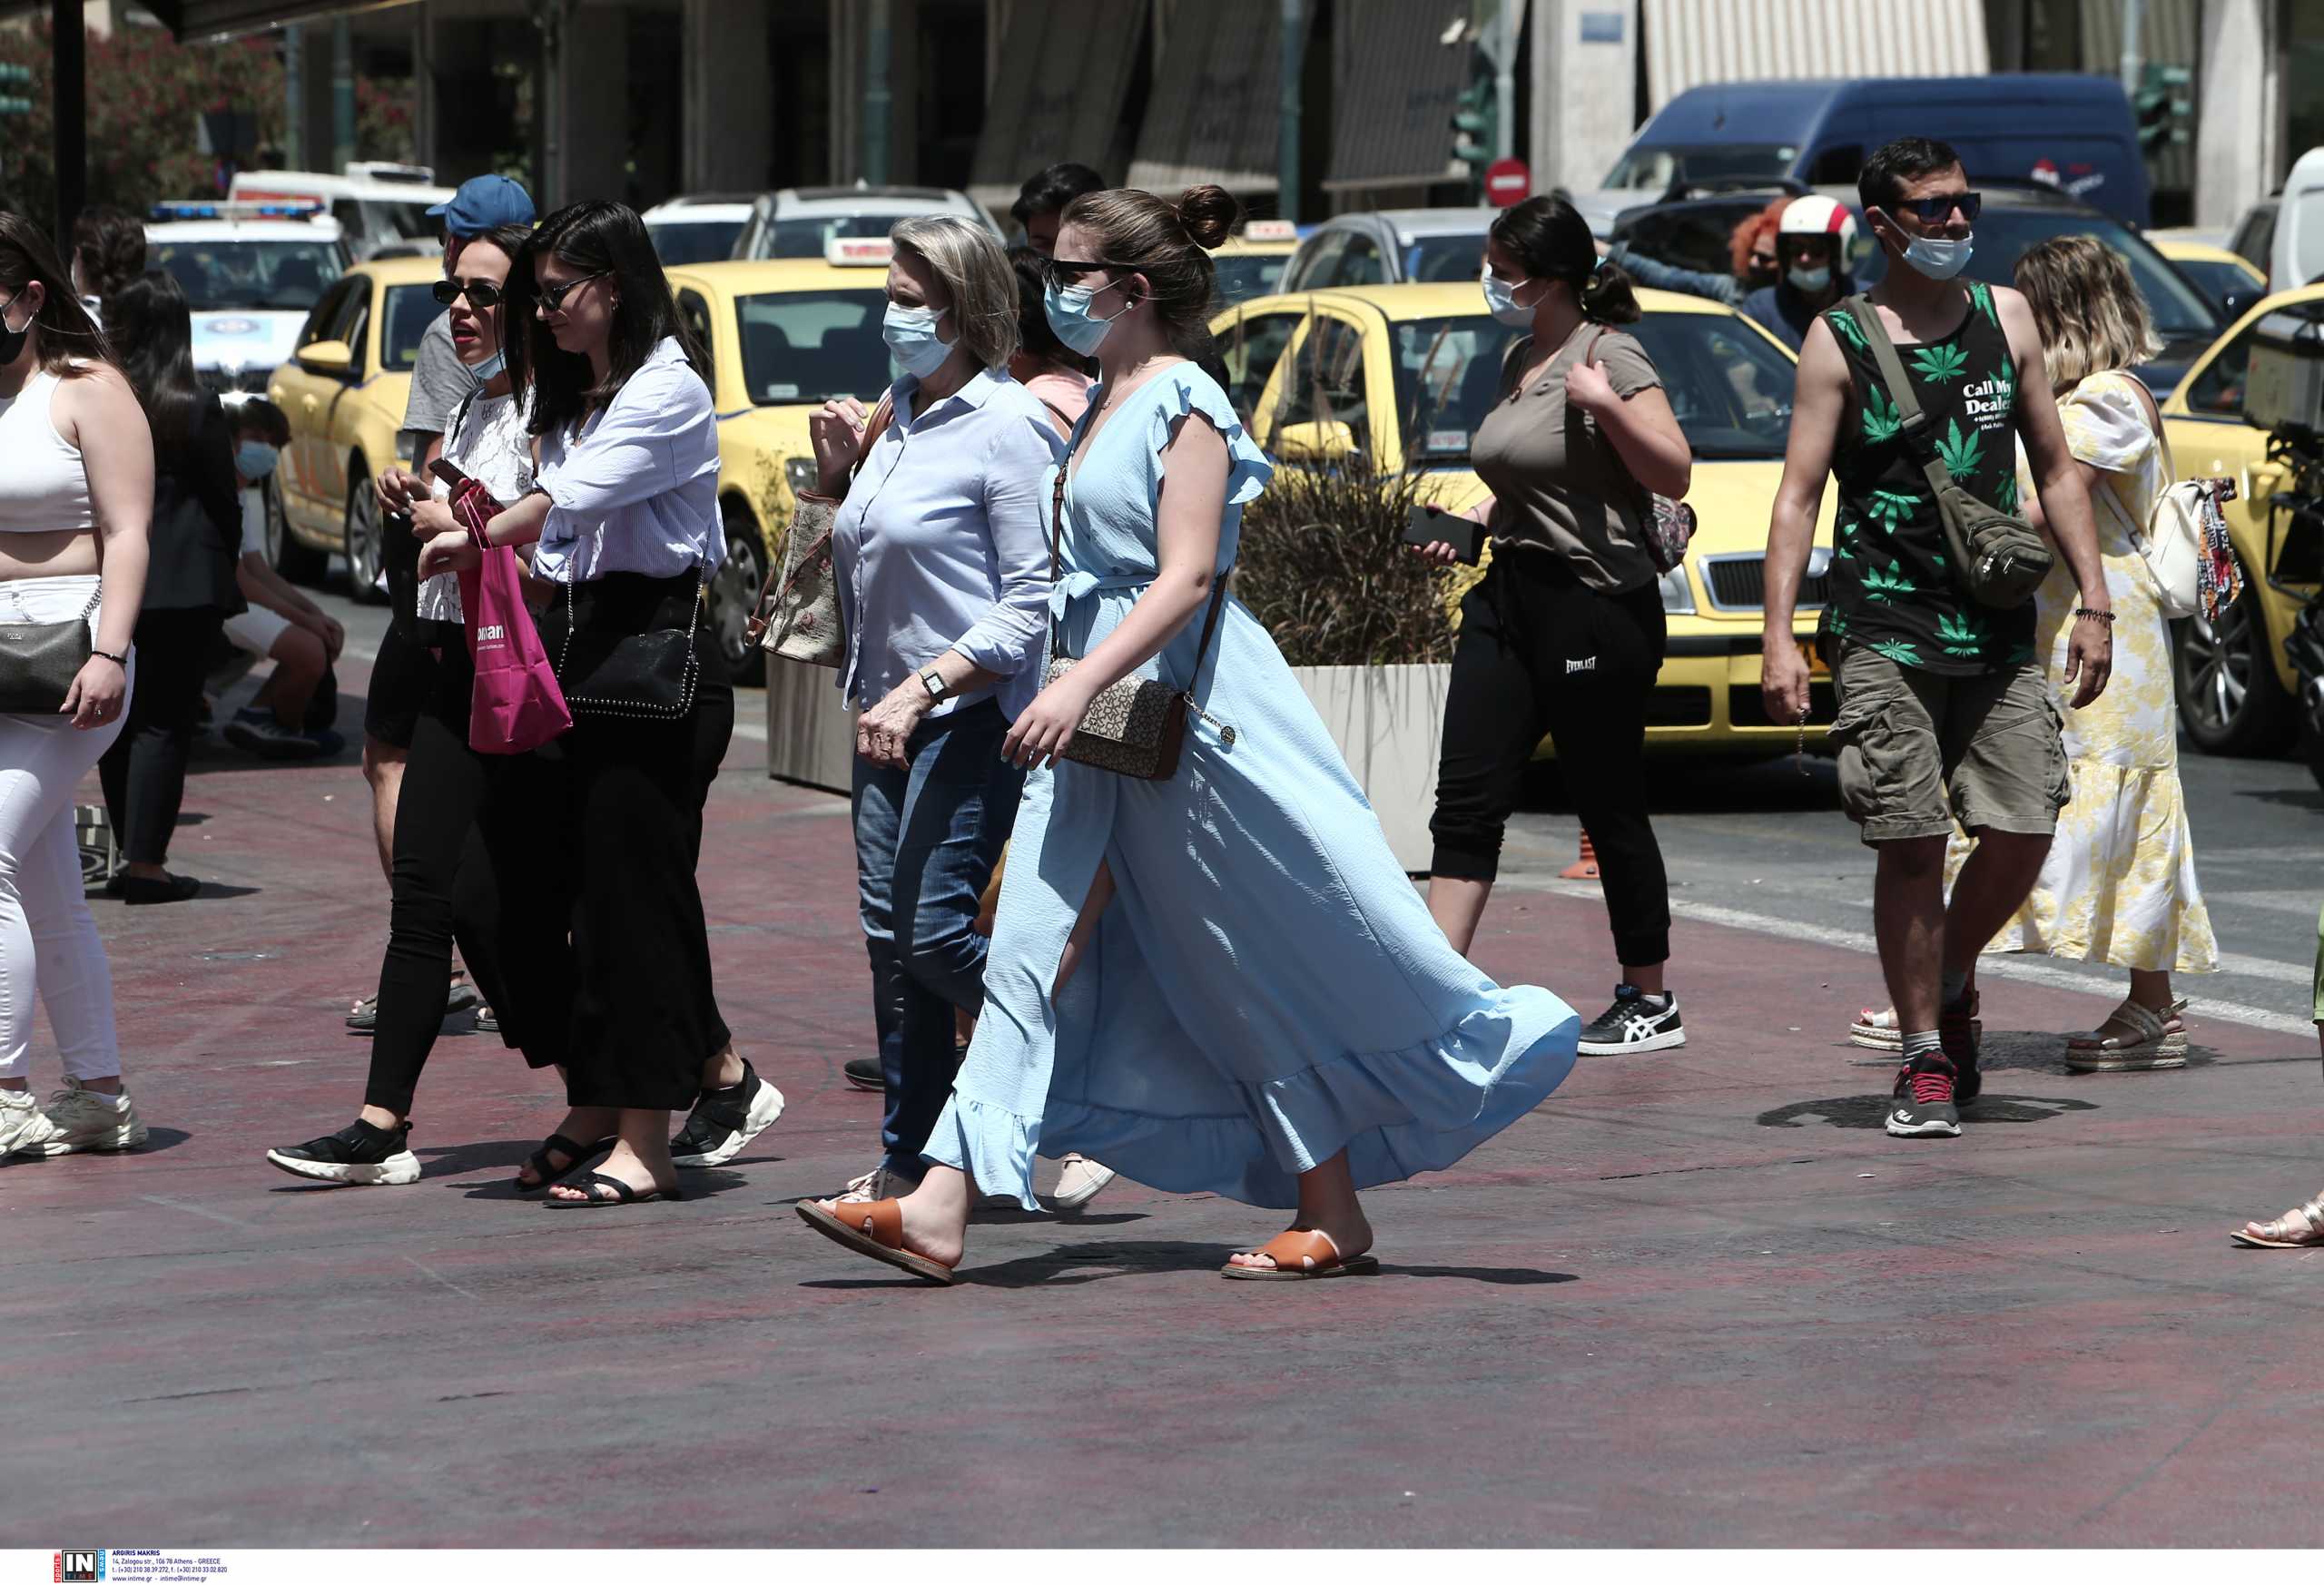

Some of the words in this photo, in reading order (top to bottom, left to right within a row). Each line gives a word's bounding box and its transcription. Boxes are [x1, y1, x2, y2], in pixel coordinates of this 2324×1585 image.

[1963, 380, 1994, 398] Call
[1996, 379, 2012, 398] My
[1565, 655, 1596, 674] EVERLAST
